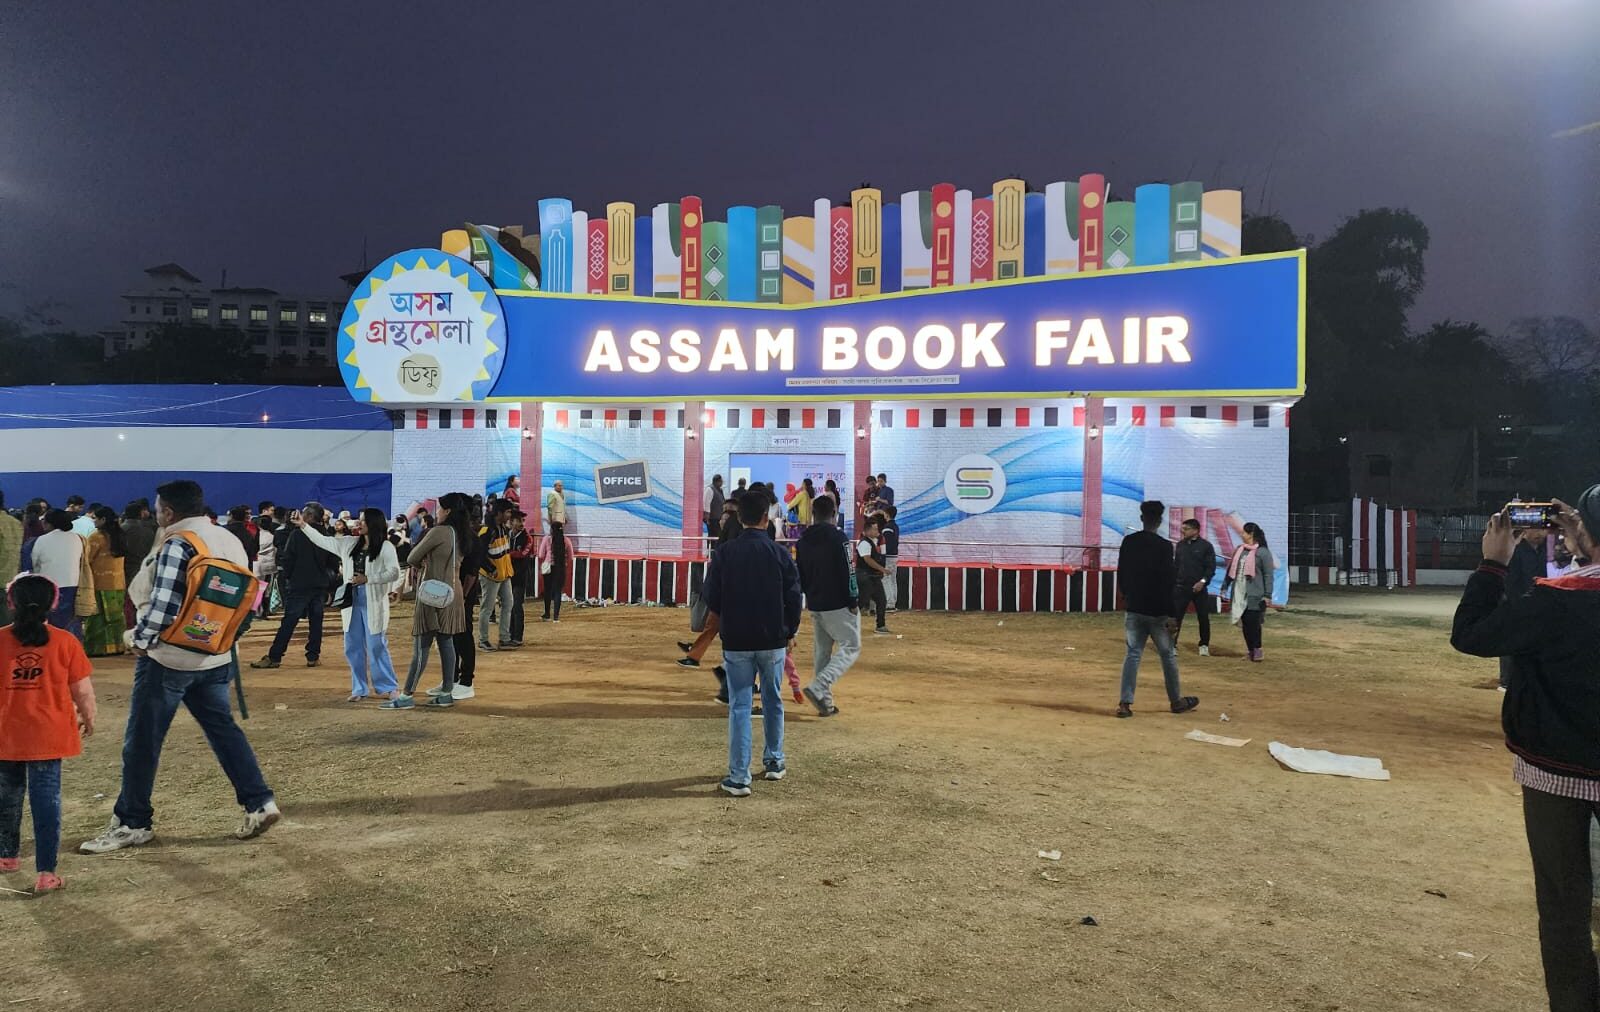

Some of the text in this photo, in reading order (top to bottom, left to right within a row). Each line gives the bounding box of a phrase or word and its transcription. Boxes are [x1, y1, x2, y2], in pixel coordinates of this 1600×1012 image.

[389, 292, 453, 316] অসম
[584, 316, 1192, 372] ASSAM BOOK FAIR
[400, 360, 438, 389] ডিফু
[603, 476, 642, 486] OFFICE
